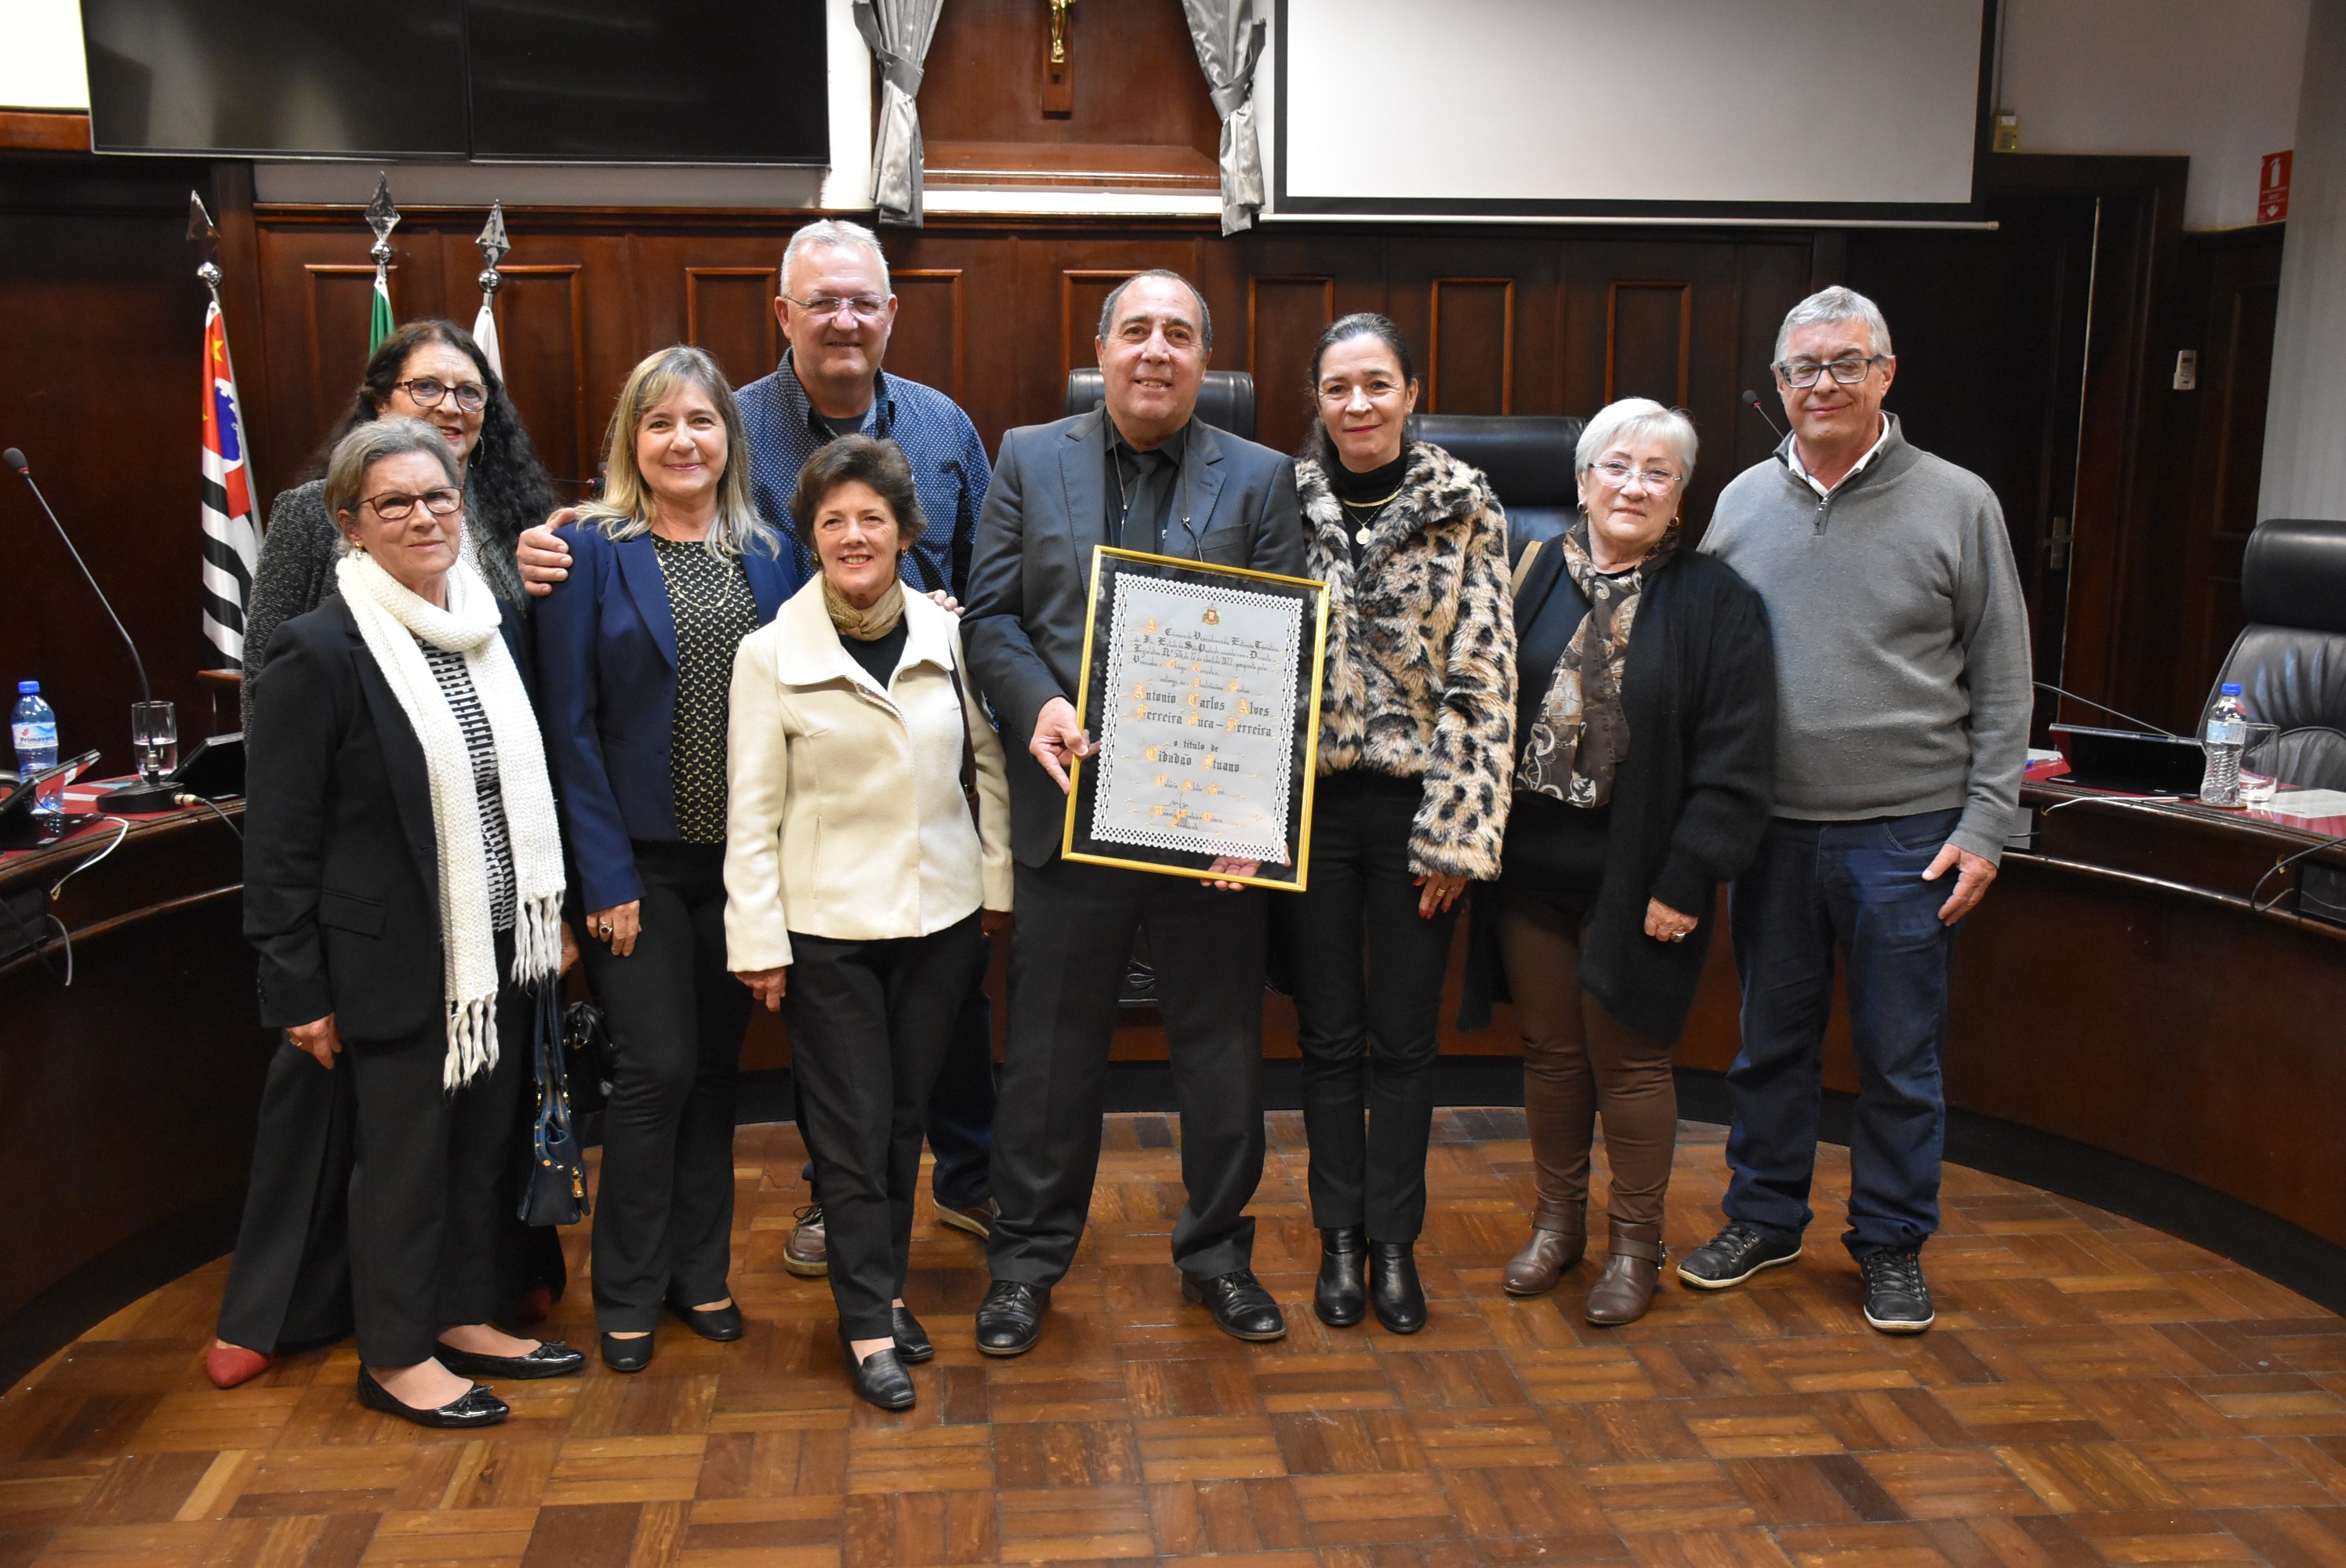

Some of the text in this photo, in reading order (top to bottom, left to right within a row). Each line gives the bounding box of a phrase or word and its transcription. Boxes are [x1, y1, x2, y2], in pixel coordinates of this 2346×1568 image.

[1135, 683, 1269, 717] Antonio Carlos Alves
[1136, 705, 1182, 724] Ferreira
[1188, 712, 1214, 729] Juca
[1226, 717, 1271, 737] Ferreira
[1146, 746, 1240, 772] Cidadão Ituano
[1183, 739, 1205, 750] título
[1211, 744, 1219, 753] de
